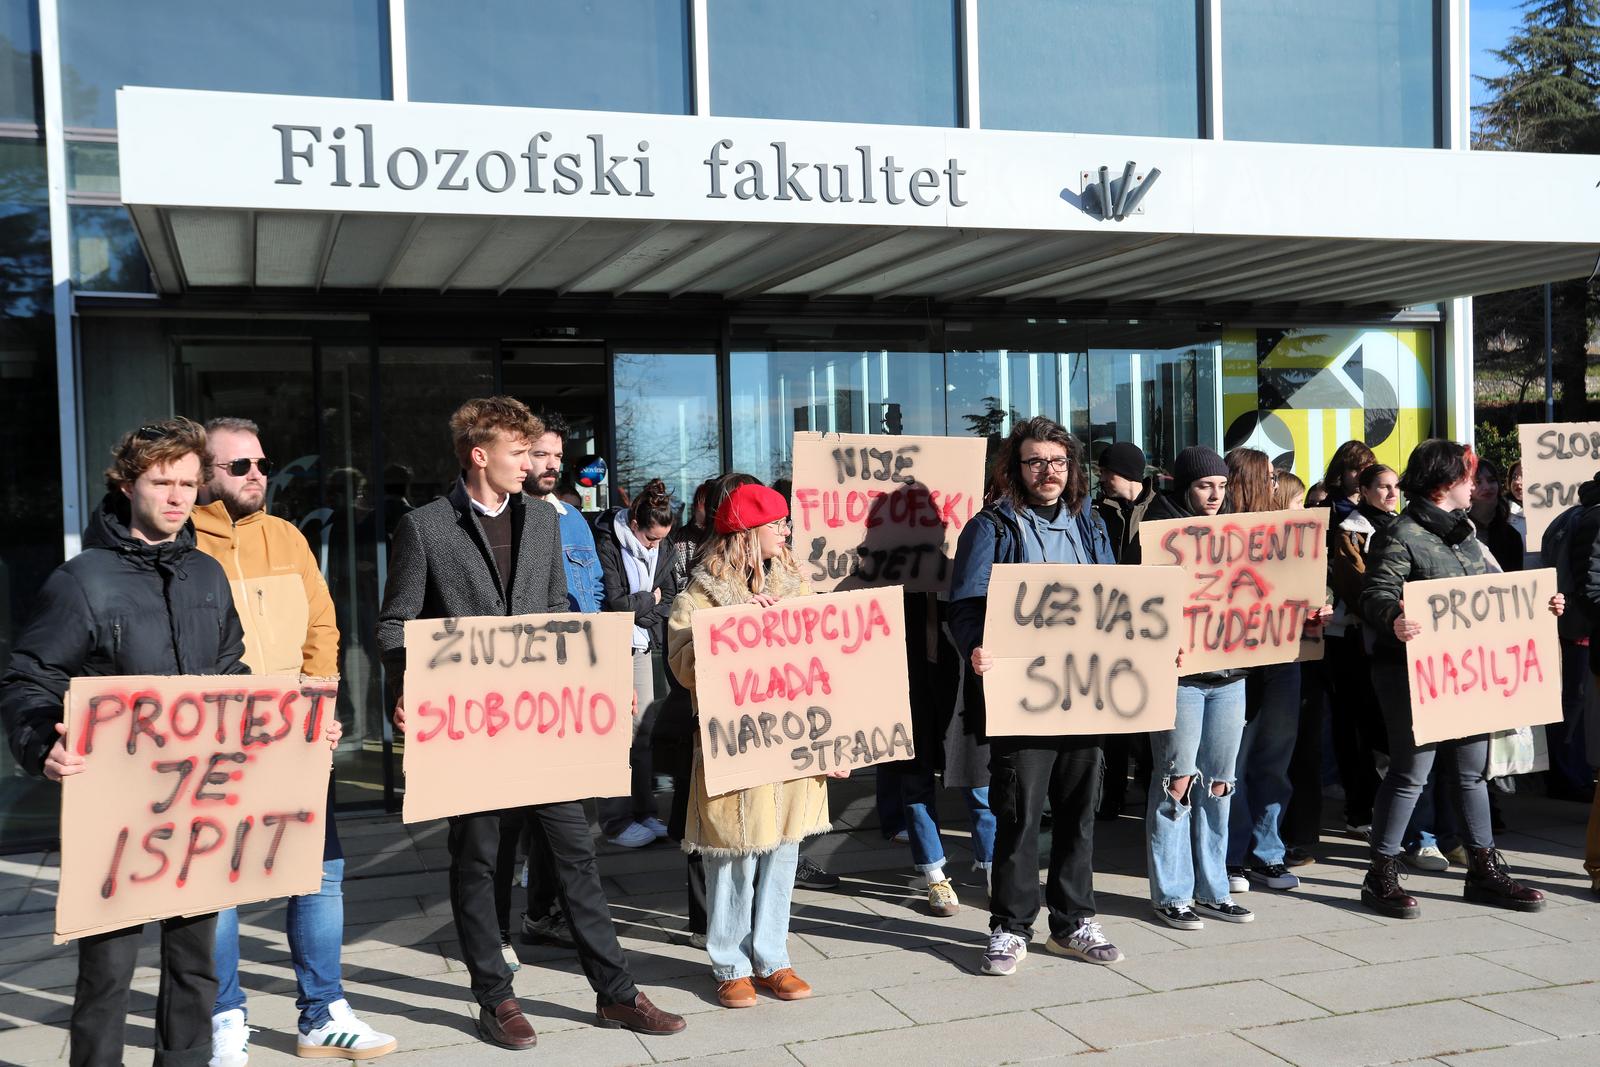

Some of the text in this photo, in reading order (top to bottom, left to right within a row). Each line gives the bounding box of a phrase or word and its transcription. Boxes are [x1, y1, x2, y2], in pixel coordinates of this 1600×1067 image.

[272, 124, 968, 207] Filozofski fakultet
[832, 445, 921, 485] NIJE
[795, 488, 973, 532] FILOZOFSKI
[1528, 481, 1582, 508] STU
[1160, 520, 1322, 568] STUDENTI
[1014, 581, 1169, 640] UZ VAS
[1189, 566, 1275, 604] ZA
[1427, 579, 1538, 632] PROTIV
[709, 599, 890, 655] KORUPCIJA
[1183, 598, 1321, 653] TUDENT
[729, 656, 832, 706] VLADA
[1019, 653, 1149, 718] SMO
[1415, 638, 1543, 705] NASILJA
[76, 686, 337, 755] PROTEST
[416, 686, 616, 742] SLOBODNO
[708, 706, 832, 758] NAROD
[790, 722, 914, 770] STRADA
[151, 752, 256, 813] JE
[101, 811, 314, 899] ISPIT
